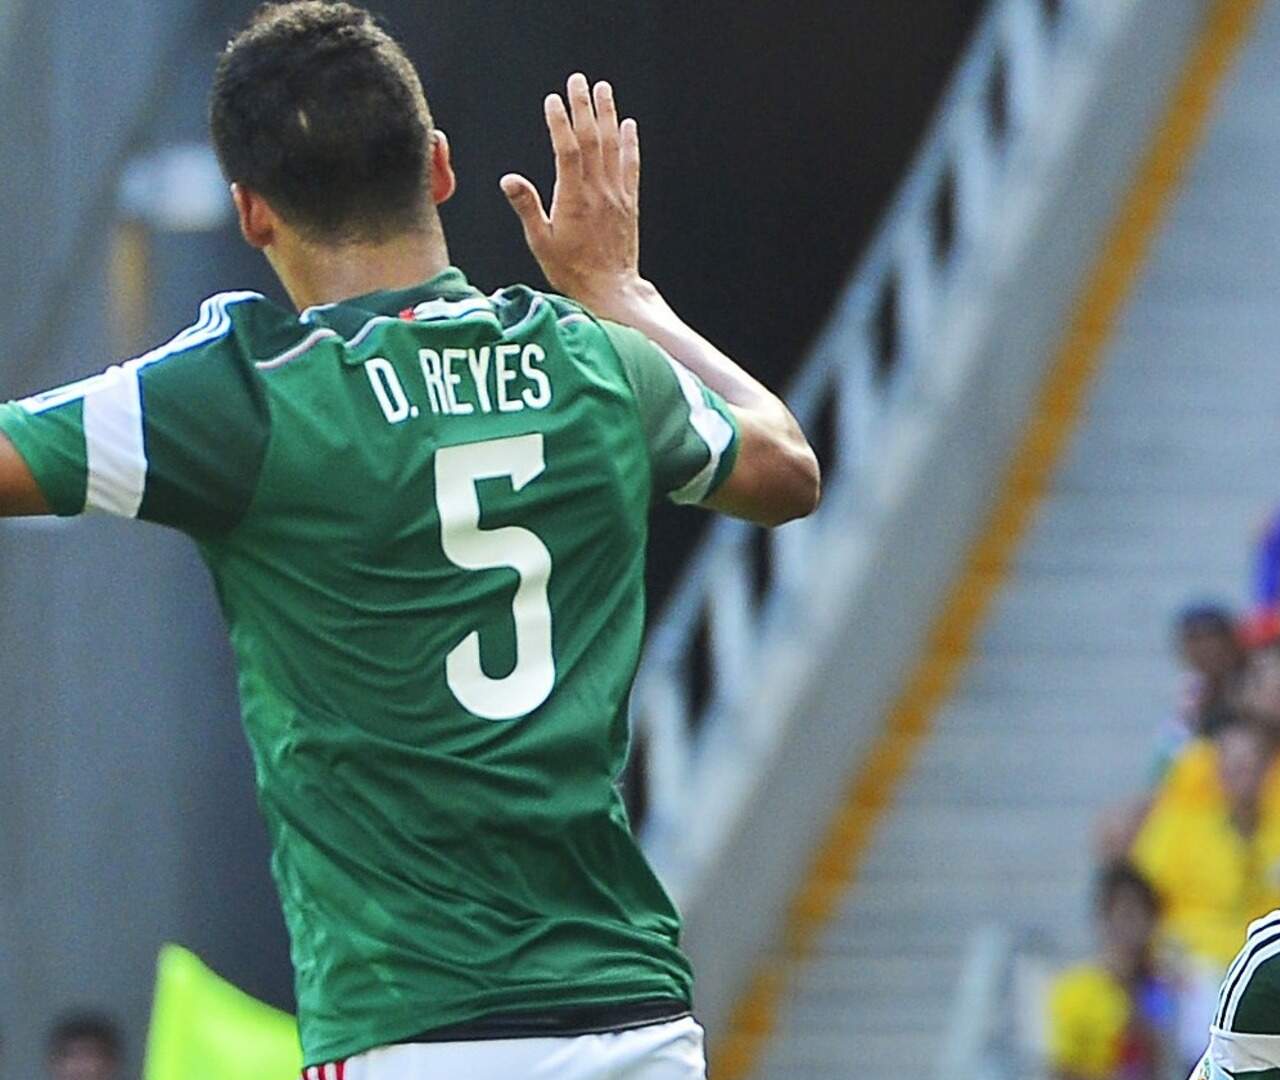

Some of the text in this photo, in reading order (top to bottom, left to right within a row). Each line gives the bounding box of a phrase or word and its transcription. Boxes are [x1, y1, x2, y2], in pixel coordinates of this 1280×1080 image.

[365, 343, 552, 424] D. REYES
[434, 432, 556, 720] 5
